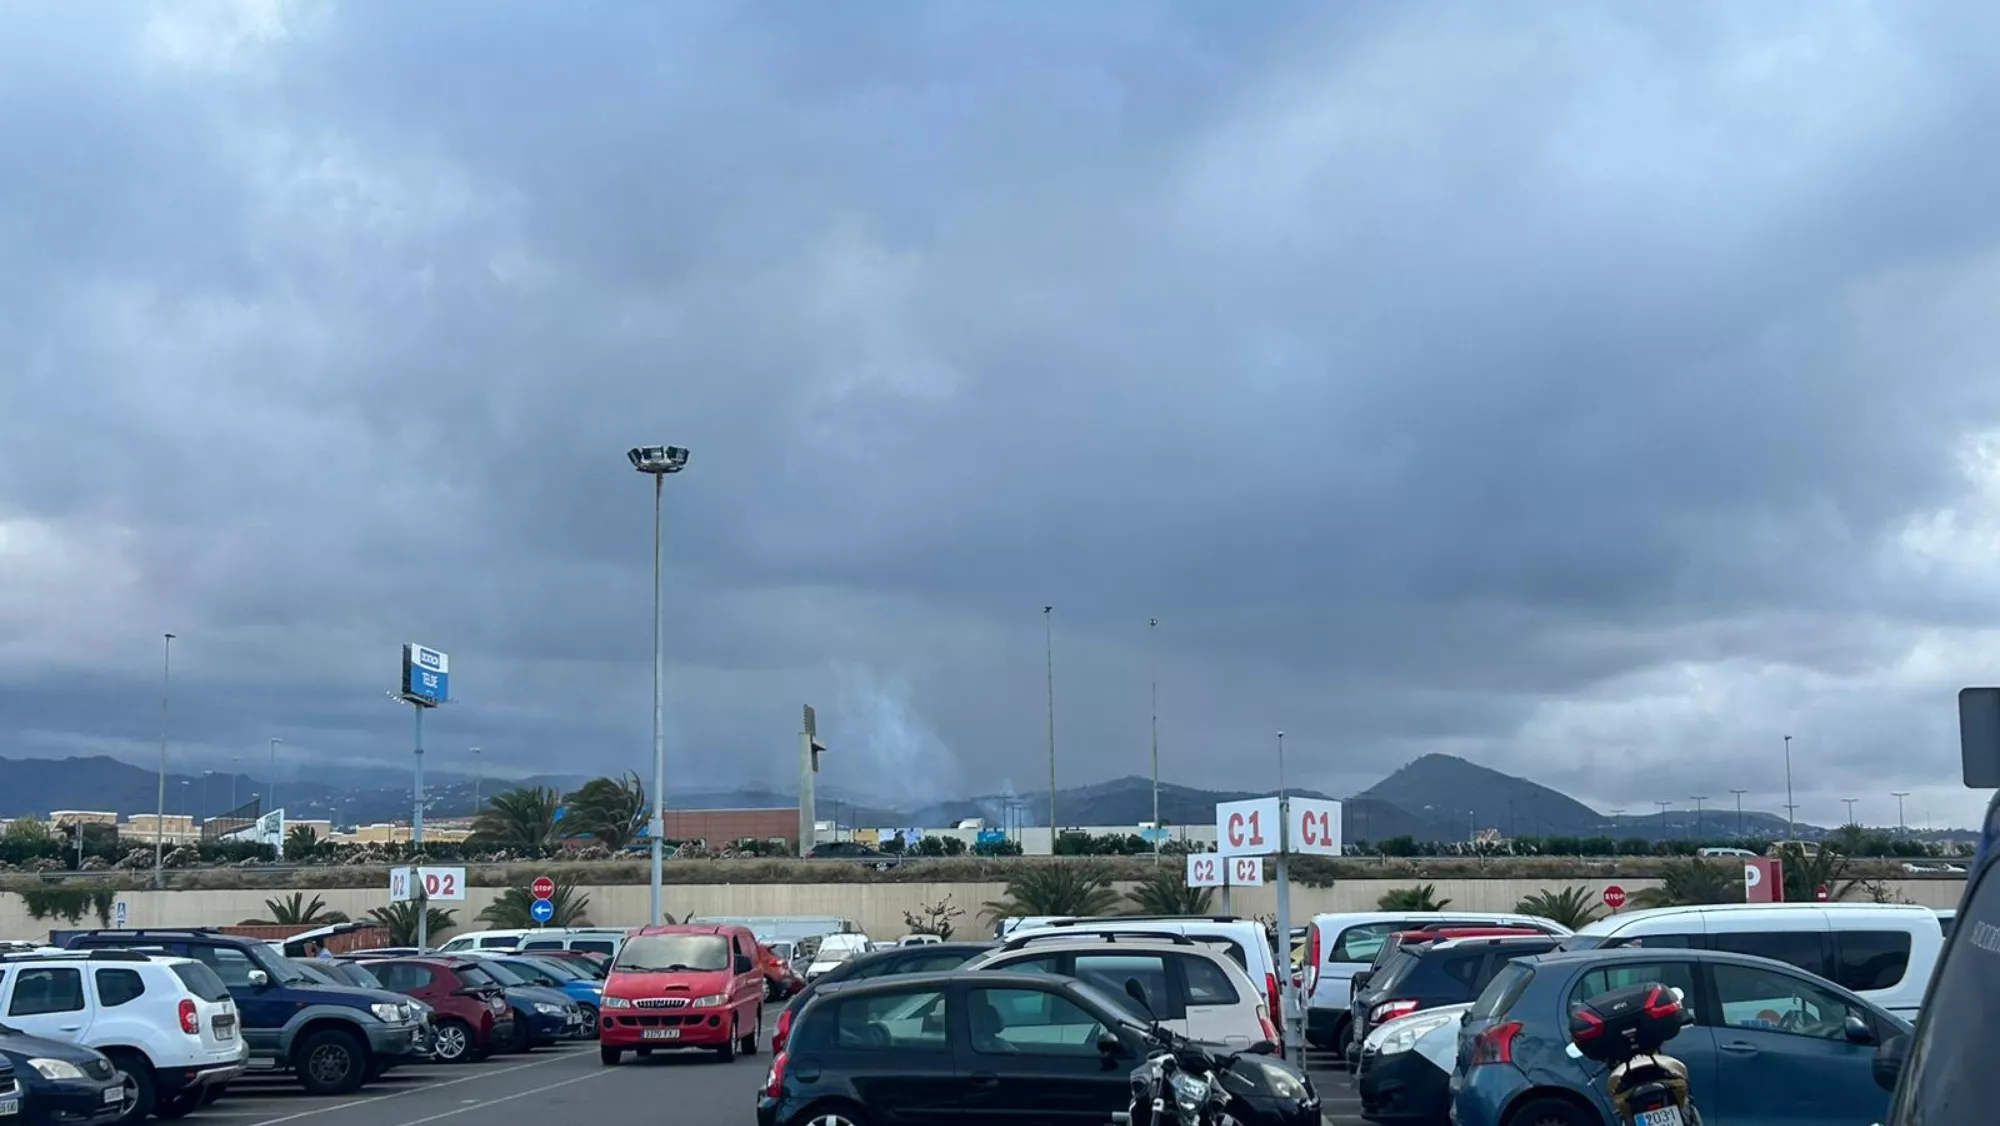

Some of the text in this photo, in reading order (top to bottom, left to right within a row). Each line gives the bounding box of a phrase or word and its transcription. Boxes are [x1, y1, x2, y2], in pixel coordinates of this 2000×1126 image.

[1228, 810, 1263, 847] C1
[1302, 810, 1332, 847] C1
[1194, 860, 1214, 881] C2
[1237, 860, 1255, 881] C2
[426, 874, 456, 895] D2
[1646, 1108, 1676, 1125] 2031
